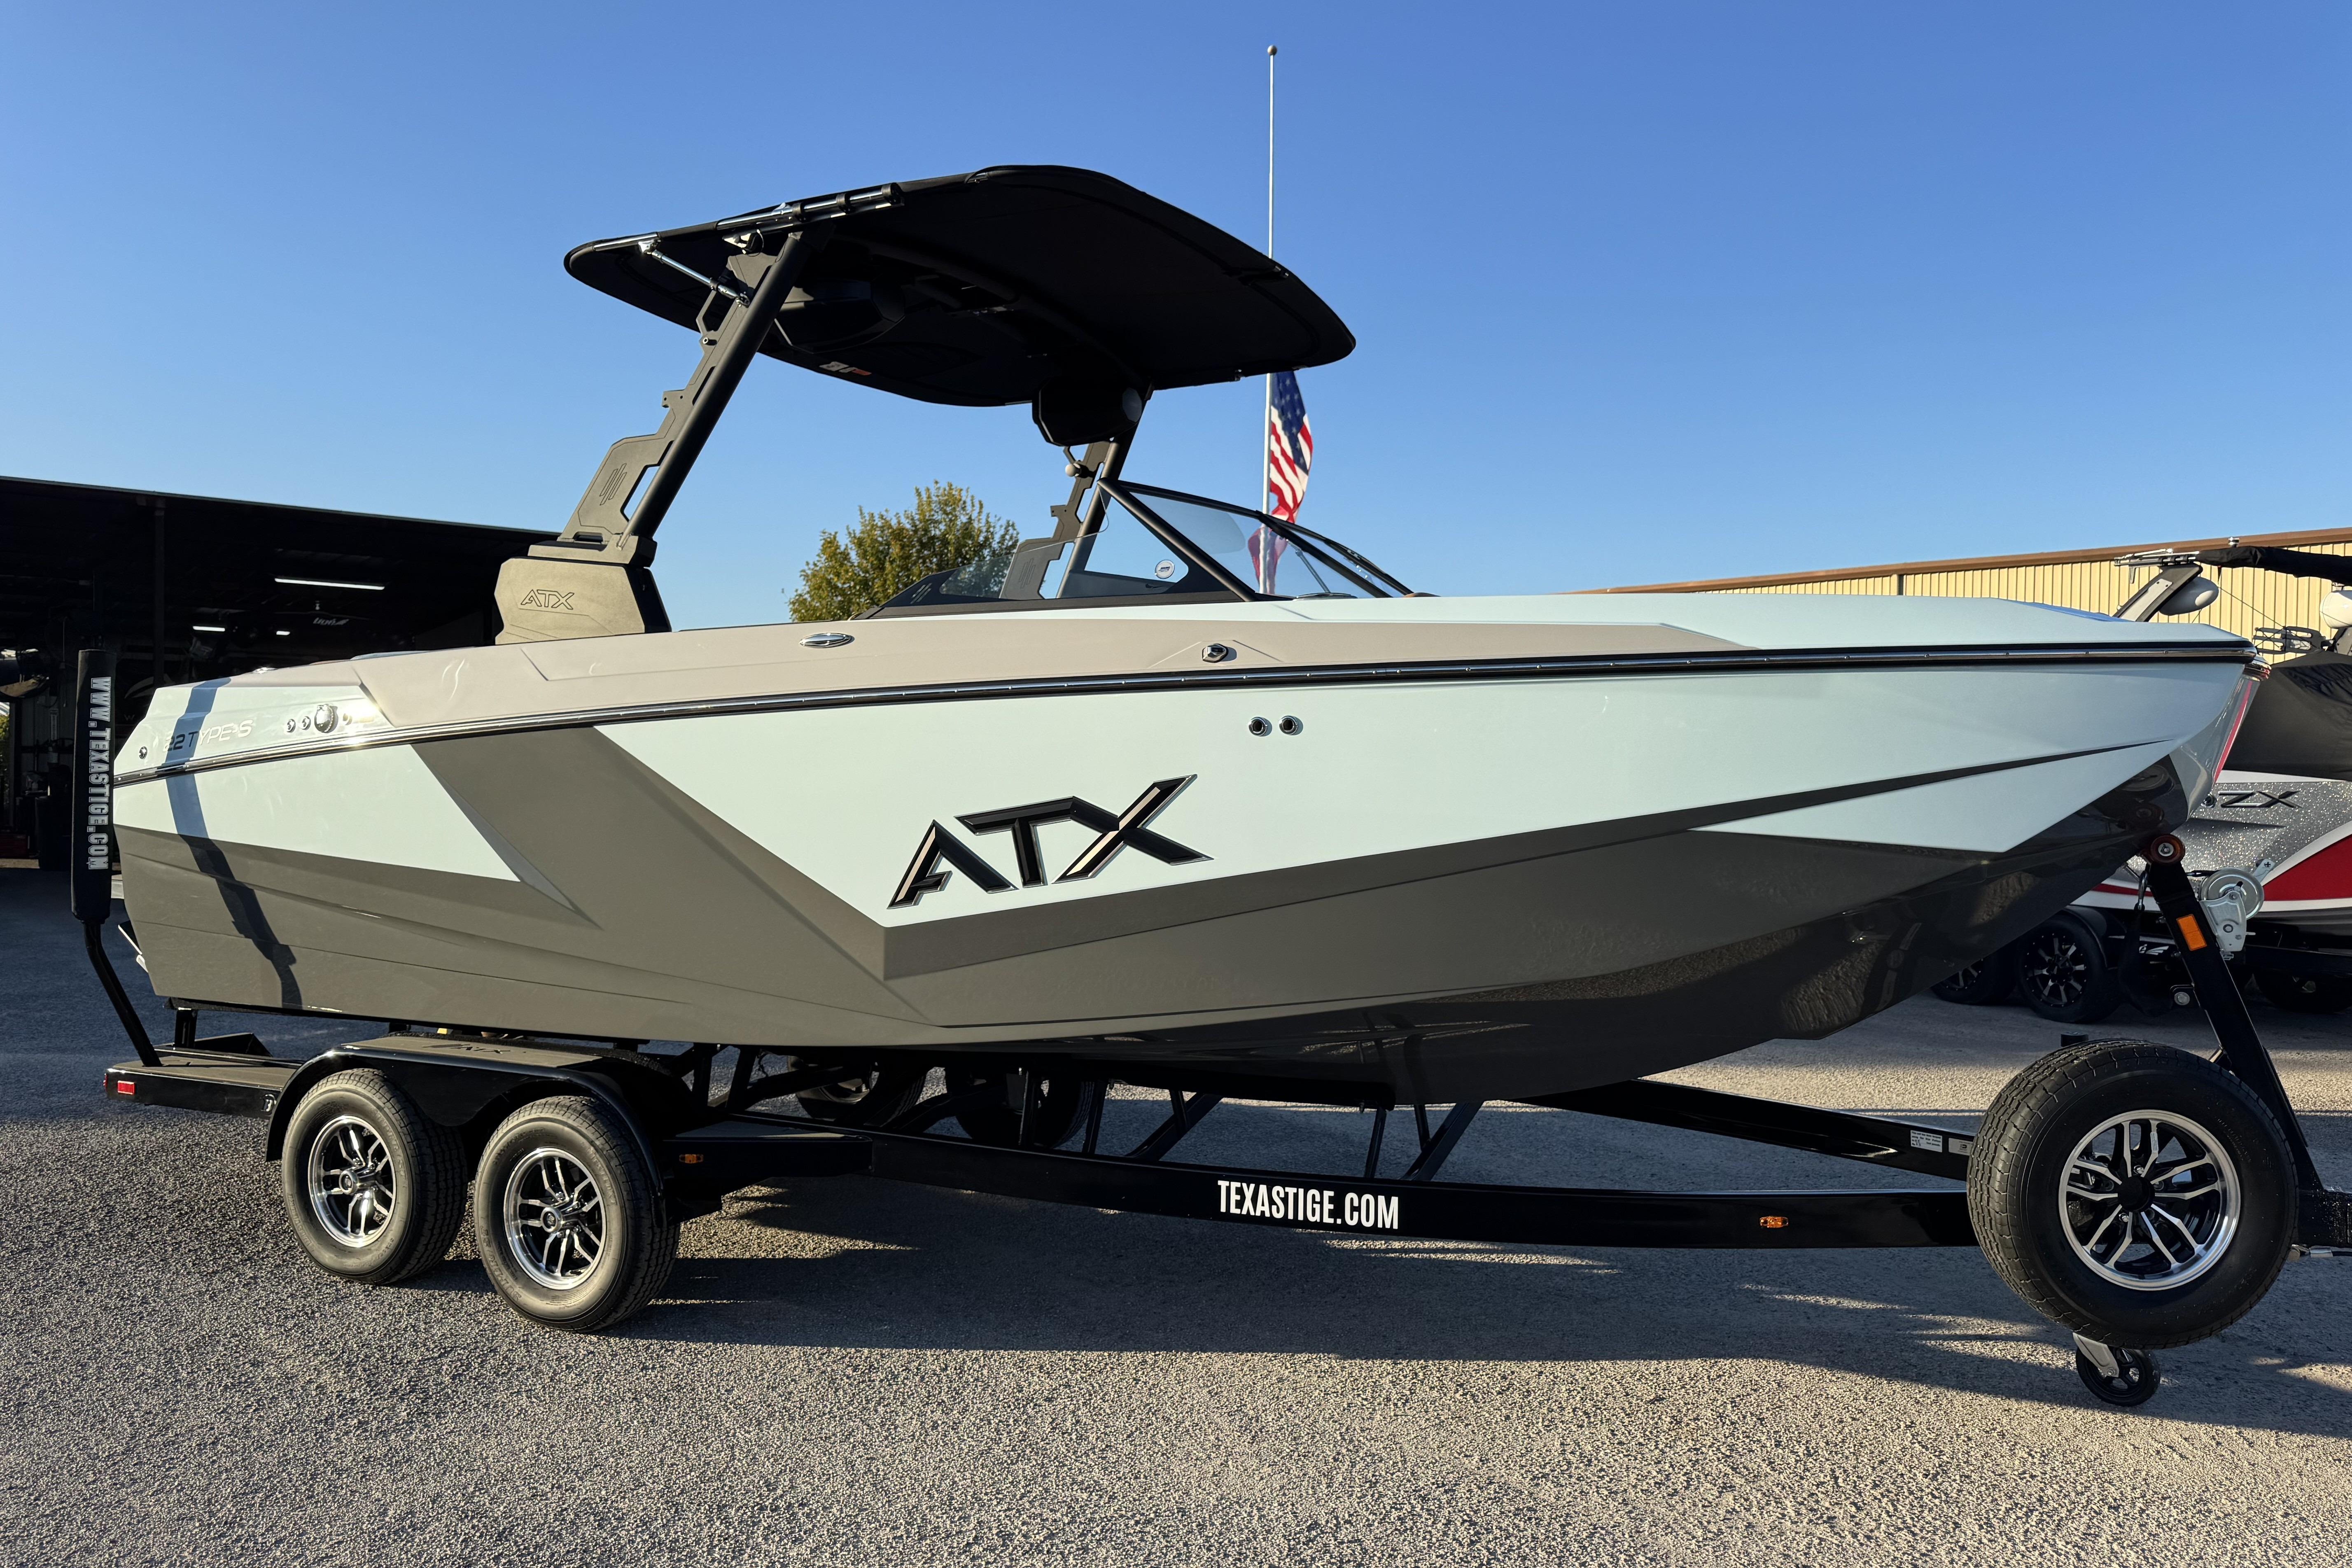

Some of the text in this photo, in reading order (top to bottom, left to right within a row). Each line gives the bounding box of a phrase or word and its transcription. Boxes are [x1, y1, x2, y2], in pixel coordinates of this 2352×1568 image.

[520, 589, 575, 610] ATX
[87, 676, 111, 870] WWW.TEXASTIGE.COM
[2218, 790, 2303, 808] ZX
[887, 774, 1214, 909] ATX
[1218, 1180, 1399, 1230] TEXASTIGE.COM
